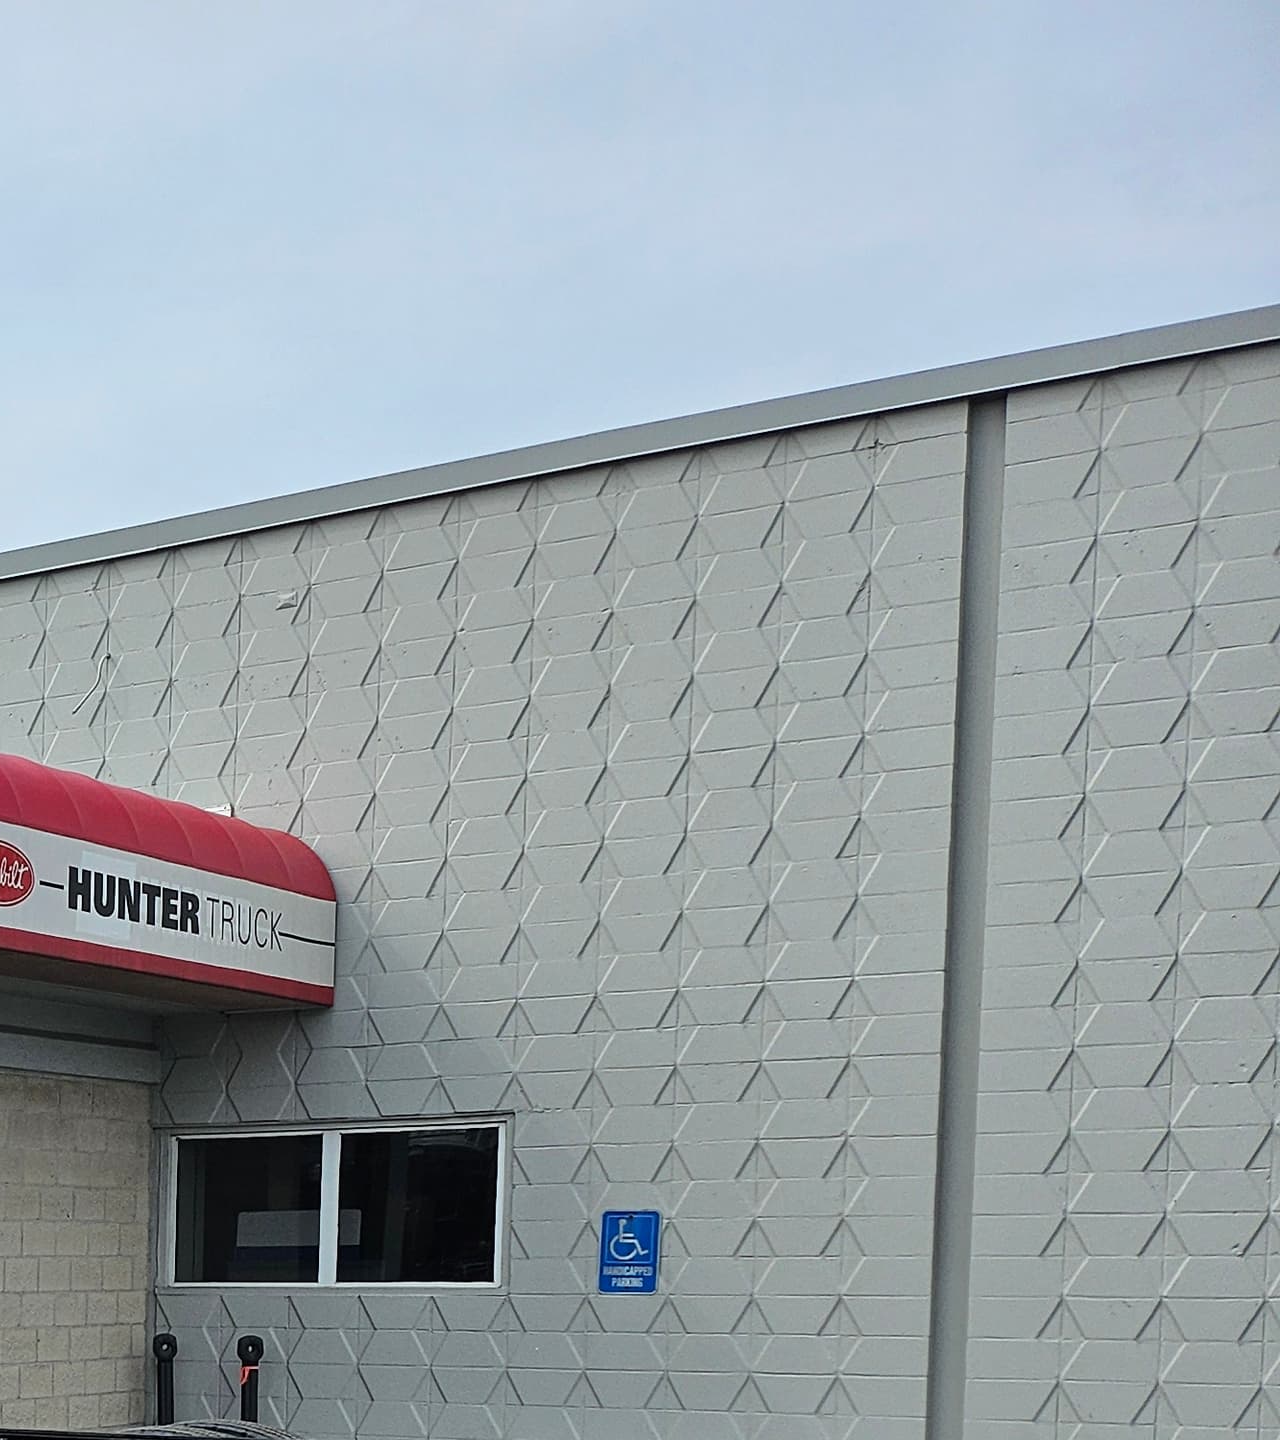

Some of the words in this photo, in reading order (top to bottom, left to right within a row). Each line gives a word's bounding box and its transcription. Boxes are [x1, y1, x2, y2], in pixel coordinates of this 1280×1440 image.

[68, 866, 200, 935] HUNTER
[206, 897, 283, 951] TRUCK
[602, 1266, 653, 1276] HANDICAPPED
[611, 1277, 643, 1287] PARKING
